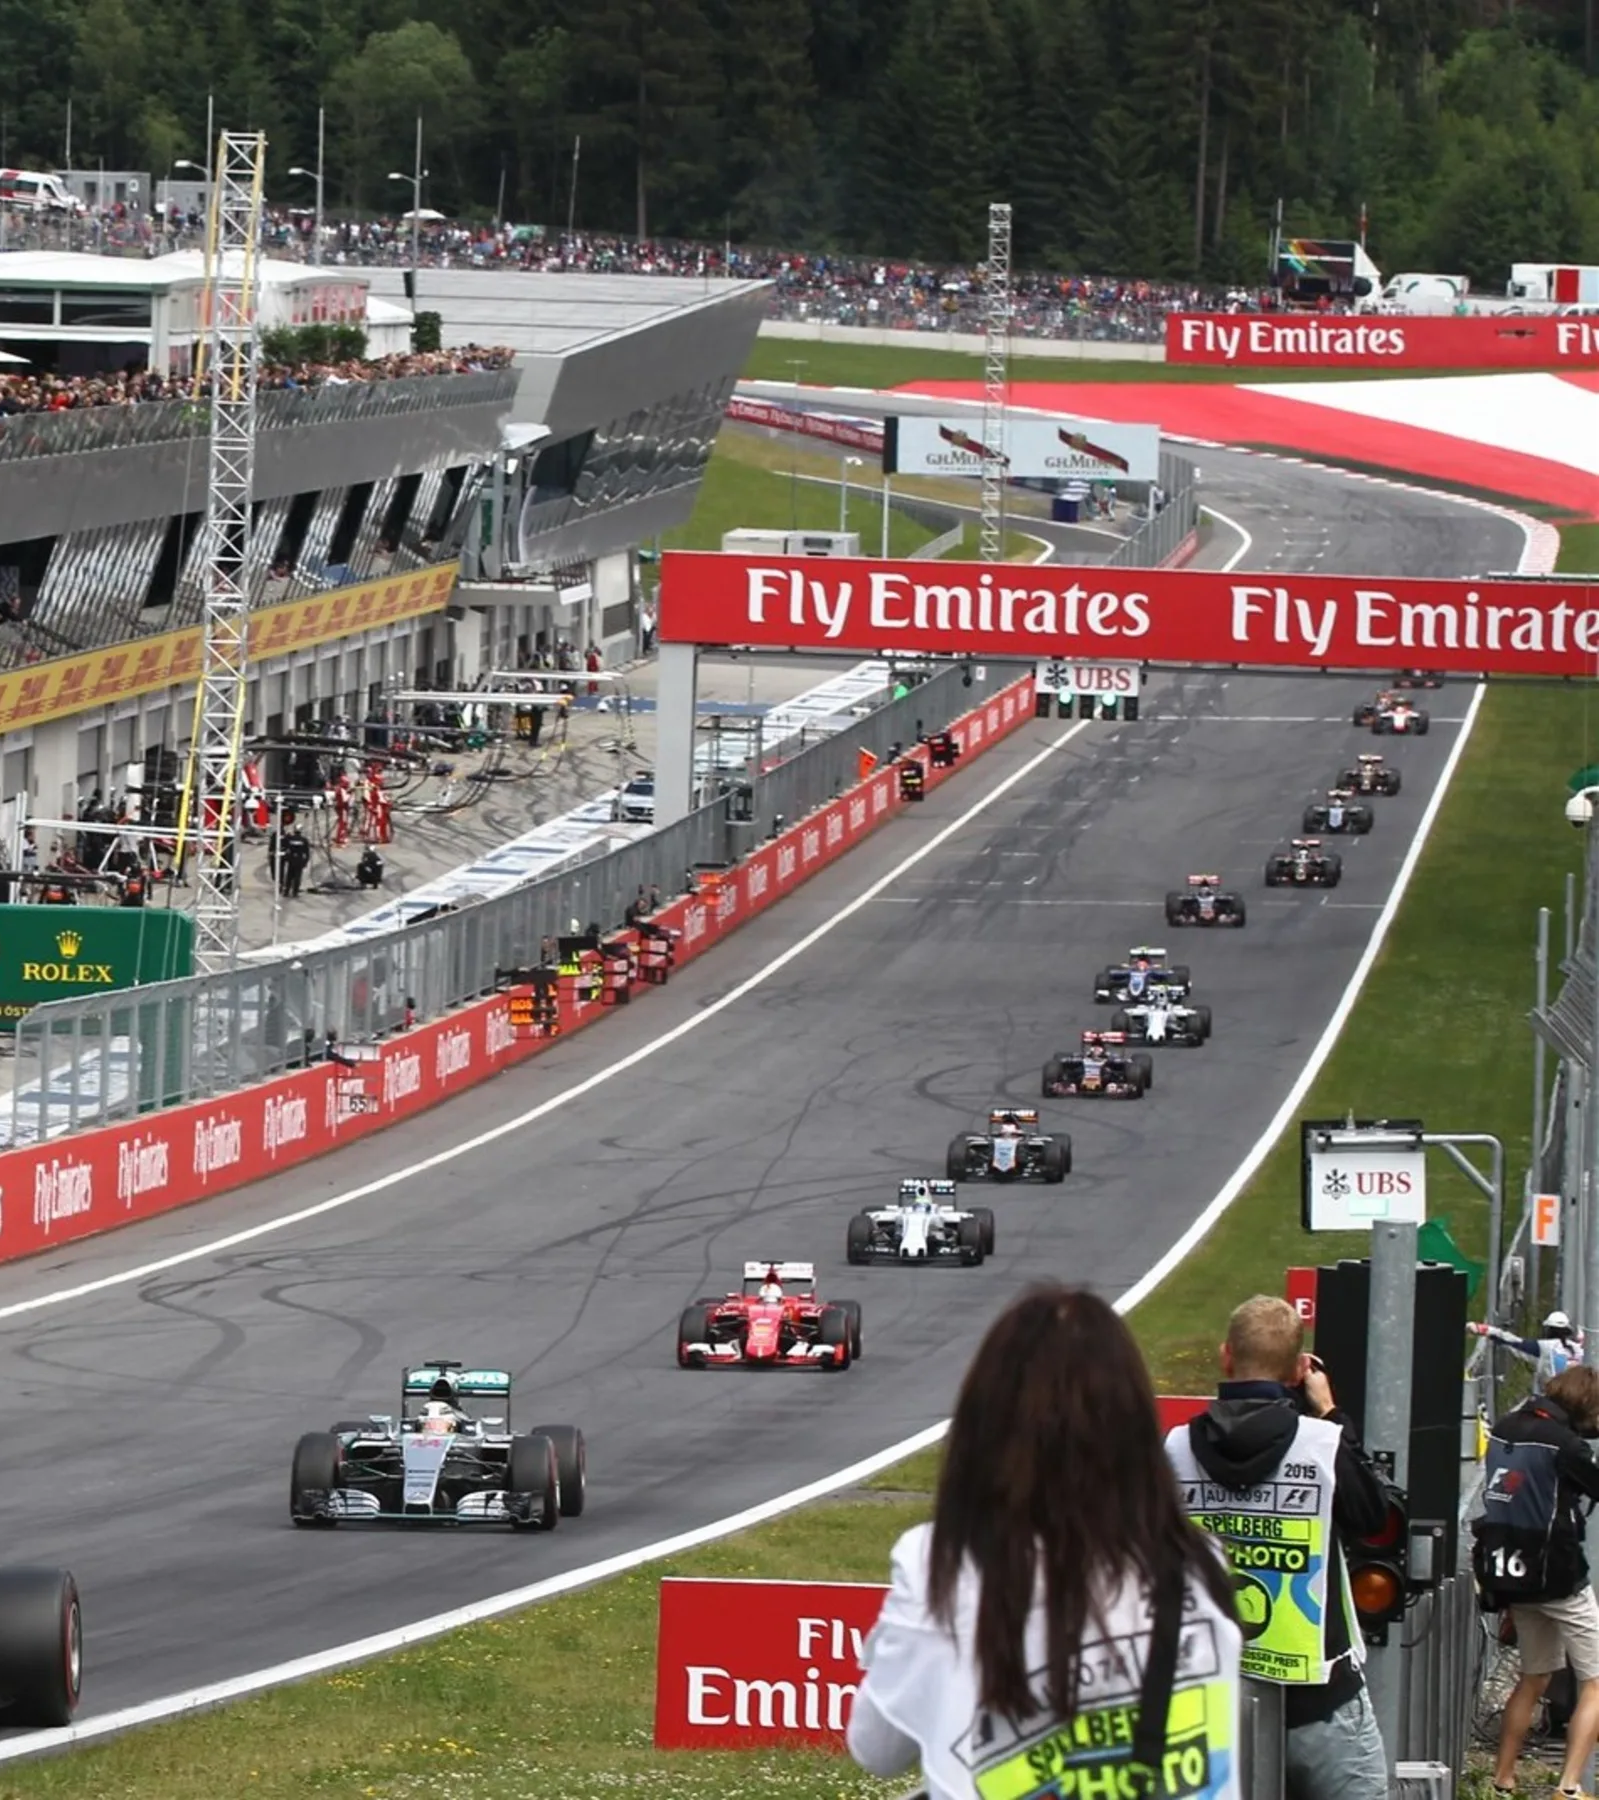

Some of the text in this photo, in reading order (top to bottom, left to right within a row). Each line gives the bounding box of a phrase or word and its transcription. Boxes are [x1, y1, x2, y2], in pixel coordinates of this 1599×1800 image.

[1182, 320, 1405, 359] Fly Emirates
[747, 569, 1151, 638] Fly Emirates
[1230, 585, 1338, 656] Fly
[1074, 666, 1131, 691] UBS
[22, 963, 113, 983] ROLEX
[1357, 1172, 1412, 1195] UBS
[1537, 1198, 1555, 1241] F
[1284, 1463, 1317, 1479] 2015
[1202, 1516, 1283, 1537] SPIELBERG
[1492, 1547, 1527, 1577] 16
[685, 1666, 858, 1730] Emir
